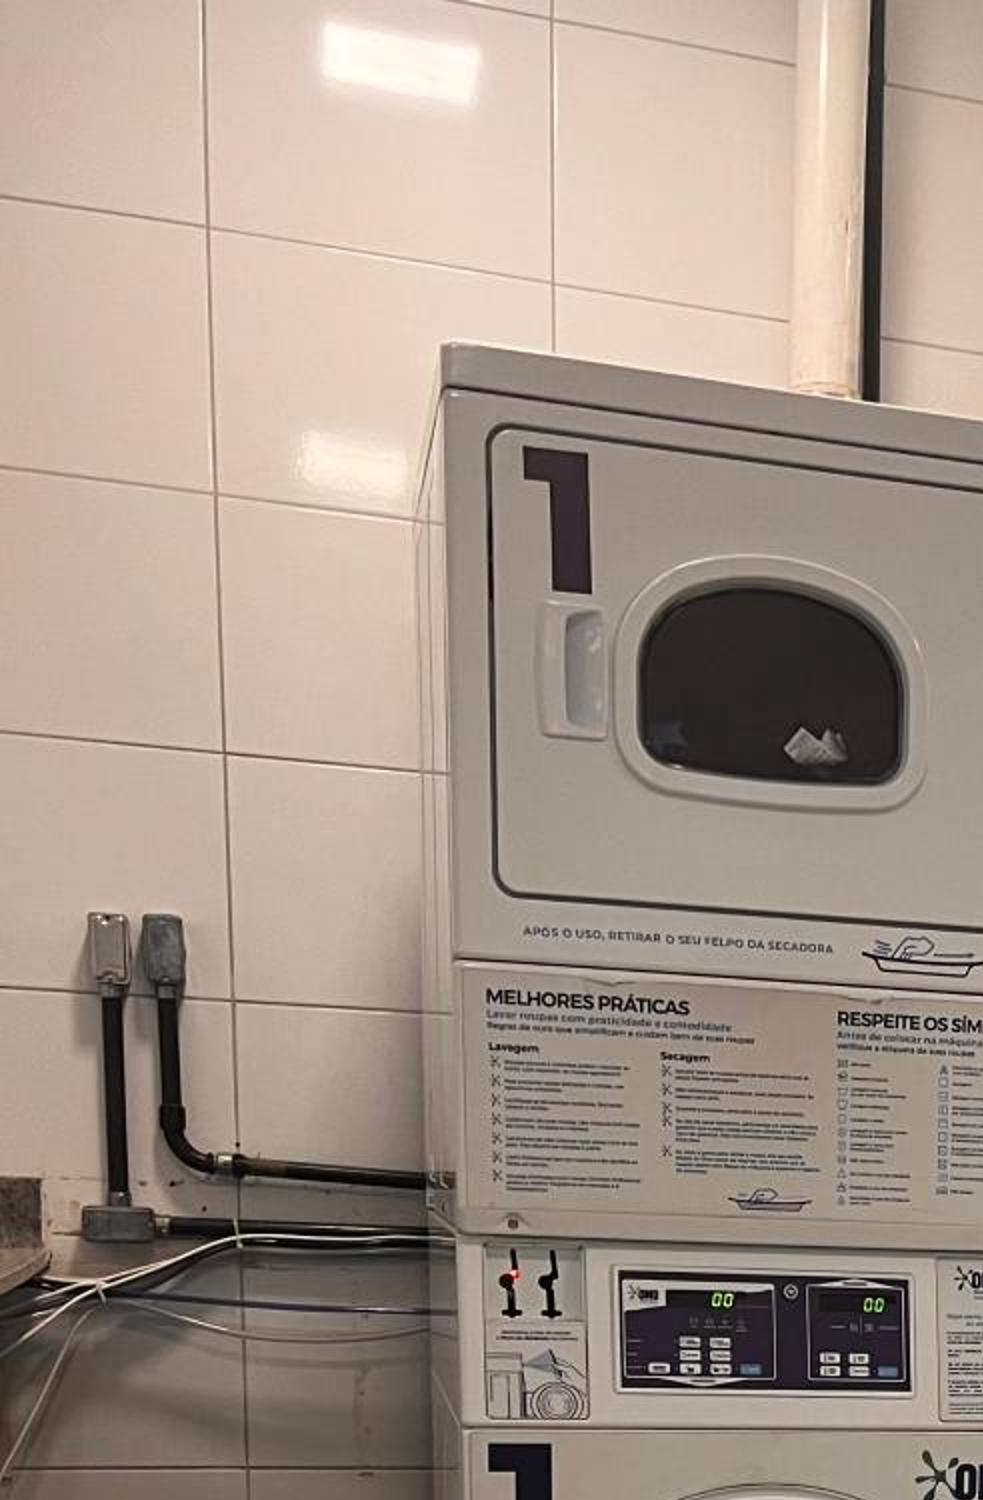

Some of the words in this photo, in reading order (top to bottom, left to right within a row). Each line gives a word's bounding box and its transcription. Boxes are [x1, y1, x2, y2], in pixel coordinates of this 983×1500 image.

[523, 446, 593, 594] 1
[562, 927, 573, 939] O
[576, 928, 605, 942] USO,
[608, 930, 660, 943] RETIRAR
[665, 934, 674, 945] O
[678, 935, 701, 945] SEU
[747, 939, 765, 950] DA
[767, 940, 833, 953] SECADORA
[486, 988, 595, 1010] MELHORES
[597, 993, 690, 1016] PRÁTICAS
[837, 1011, 921, 1031] RESPEITE
[923, 1017, 948, 1031] OS
[488, 1041, 540, 1055] Lavagem
[660, 1051, 711, 1064] Secagem
[711, 1292, 734, 1308] 00
[863, 1297, 885, 1313] 00
